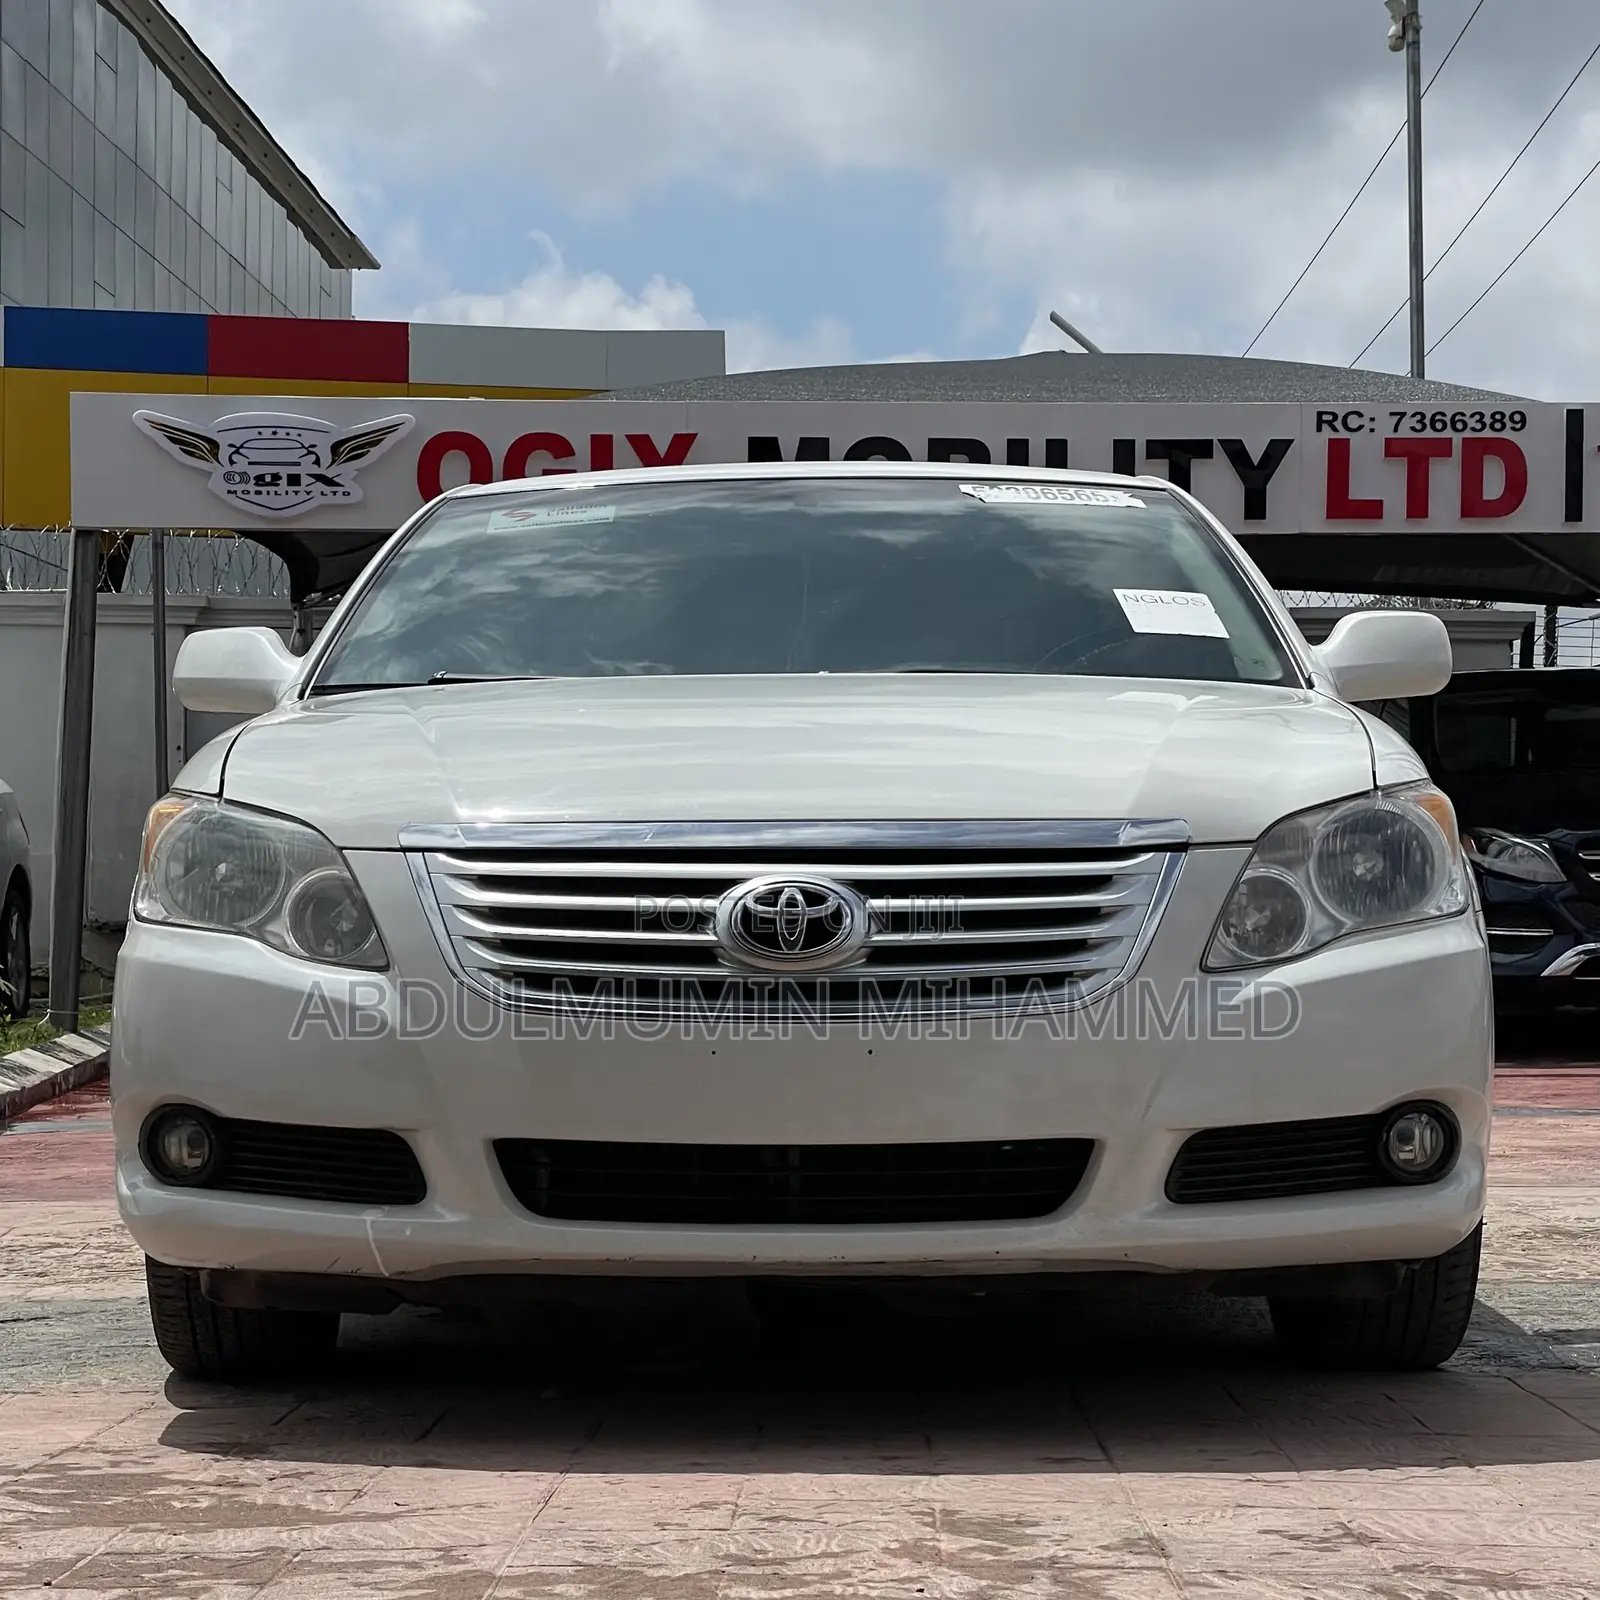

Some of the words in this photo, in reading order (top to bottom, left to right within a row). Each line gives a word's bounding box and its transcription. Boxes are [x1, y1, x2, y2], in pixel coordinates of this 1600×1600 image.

[1315, 410, 1376, 432] RC:
[1388, 410, 1528, 432] 7366389
[1325, 436, 1529, 520] LTD
[226, 489, 313, 497] MOBILITY
[1122, 593, 1206, 607] NGLOS
